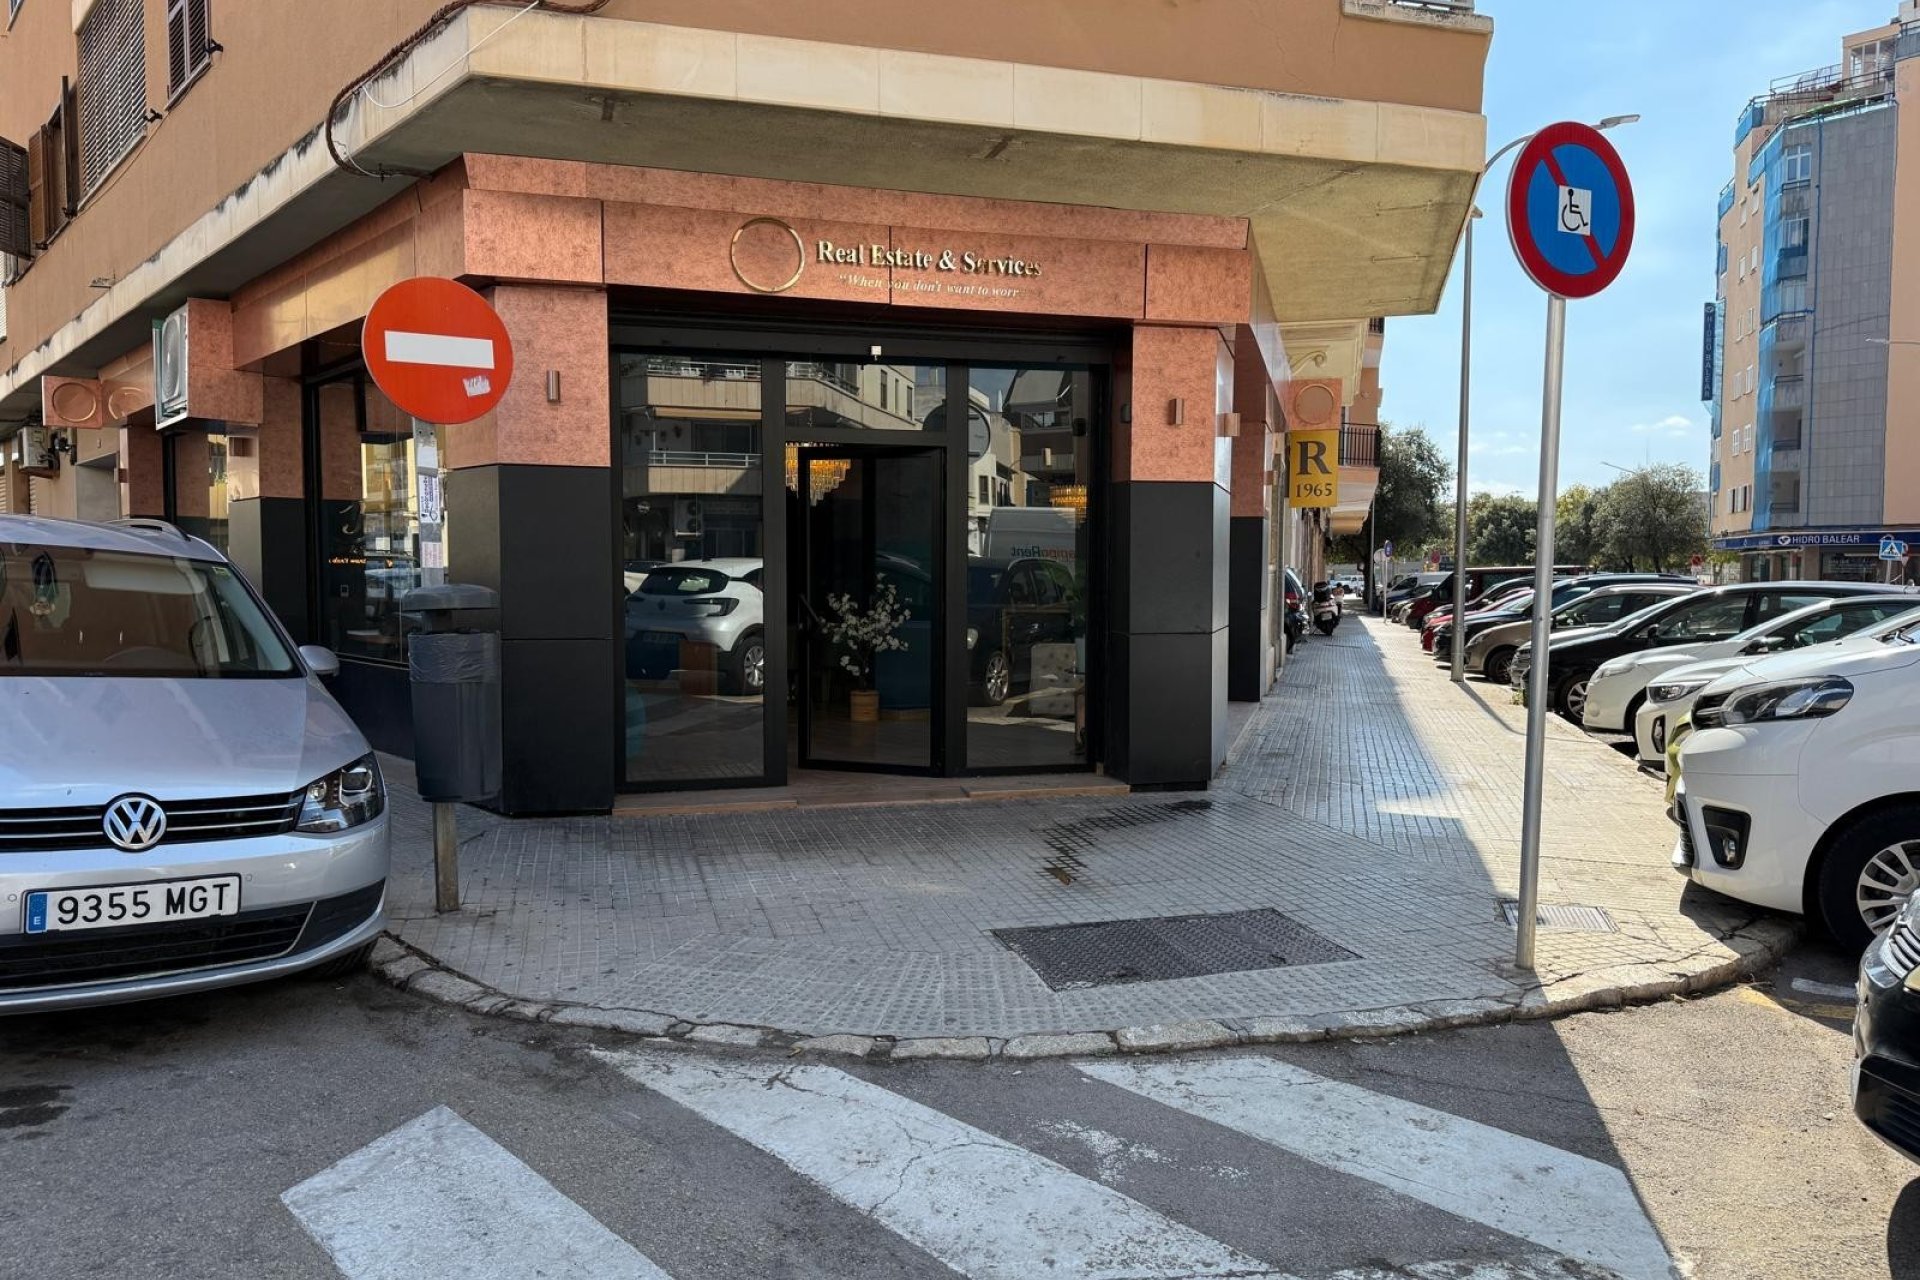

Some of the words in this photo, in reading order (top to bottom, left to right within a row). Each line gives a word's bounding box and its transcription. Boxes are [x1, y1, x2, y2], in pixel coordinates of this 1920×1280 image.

[817, 240, 864, 264] Real
[870, 243, 933, 269] Estate
[939, 249, 957, 270] &
[963, 251, 1042, 276] Services
[946, 284, 976, 295] want
[977, 285, 988, 295] to
[1296, 440, 1332, 475] R
[1296, 482, 1333, 498] 1965
[1792, 535, 1820, 545] HIDRO
[1822, 534, 1860, 544] BALEAR
[34, 916, 41, 925] E
[57, 890, 151, 925] 9355
[165, 882, 231, 916] MGT
